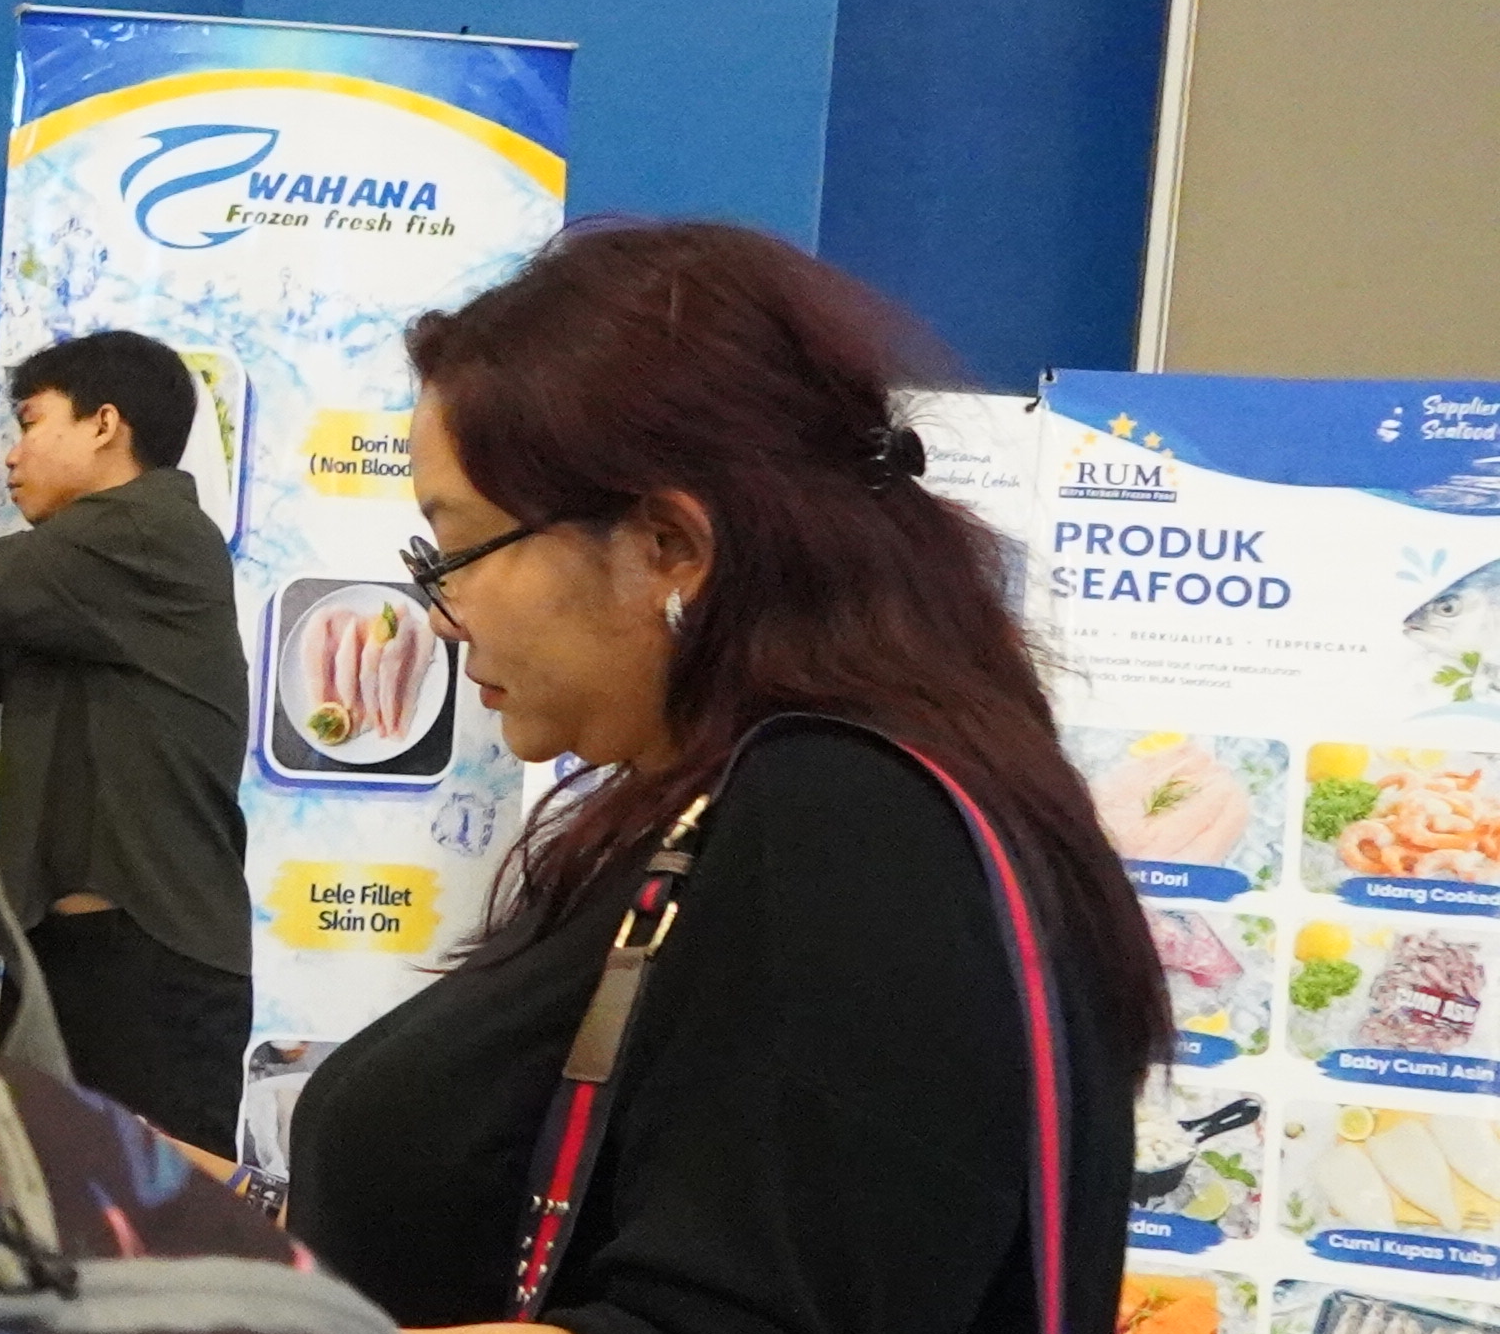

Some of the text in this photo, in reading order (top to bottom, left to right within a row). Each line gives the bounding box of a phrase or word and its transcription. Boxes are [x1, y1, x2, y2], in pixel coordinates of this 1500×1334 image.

[248, 172, 437, 211] WAHANA
[225, 204, 456, 236] Frozen fresh fish
[1423, 394, 1500, 421] Supplier
[1421, 419, 1497, 441] Seafood
[351, 435, 411, 454] Dori Ni
[320, 457, 357, 474] Non
[1077, 462, 1163, 487] RUM
[1054, 522, 1265, 563] PRODUK
[1050, 566, 1291, 609] SEAFOOD
[1130, 630, 1234, 646] BERKUALITAS
[1266, 638, 1368, 653] TERPERCAYA
[1150, 871, 1189, 887] Dori
[310, 883, 412, 907] Lele Fillet
[1366, 882, 1500, 906] Udang Cooked
[318, 908, 400, 933] Skin On
[1339, 1053, 1495, 1083] Baby Cumi Asin
[1132, 1218, 1172, 1237] dan
[1328, 1233, 1498, 1267] Cumi Kupas Tube
